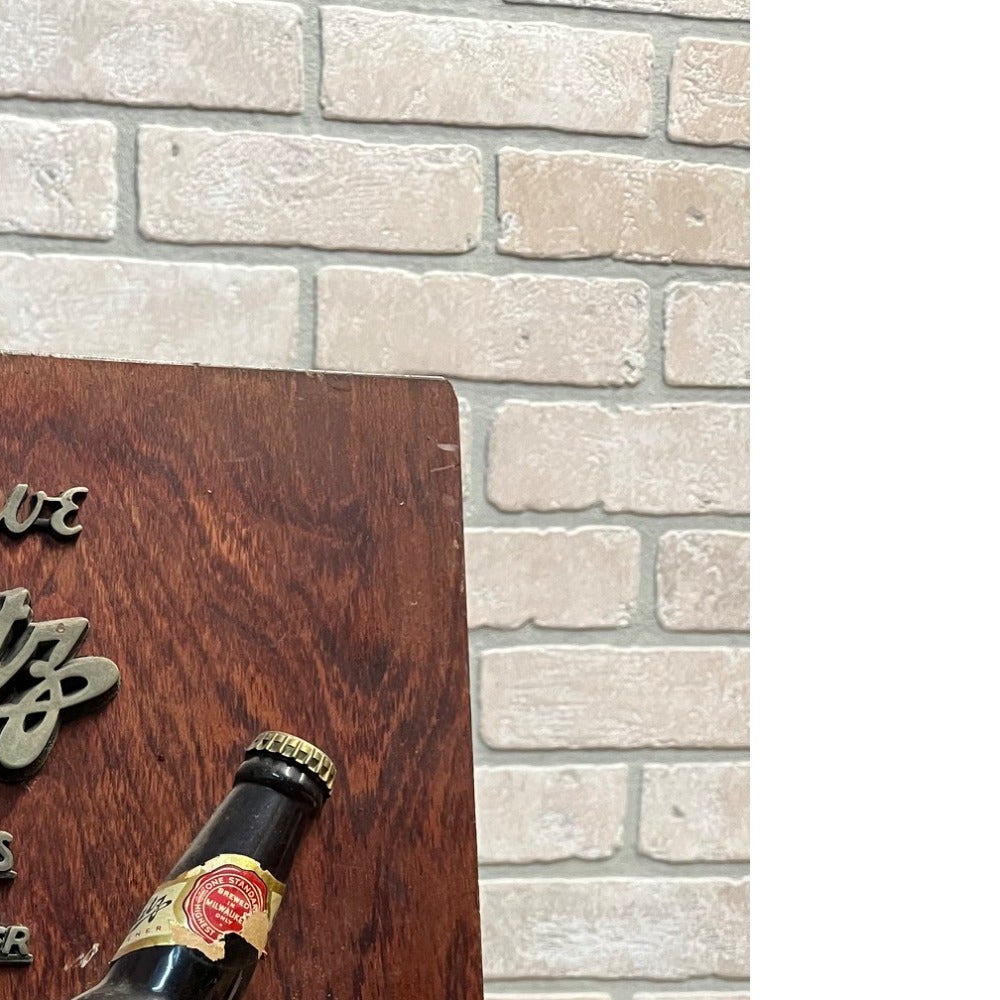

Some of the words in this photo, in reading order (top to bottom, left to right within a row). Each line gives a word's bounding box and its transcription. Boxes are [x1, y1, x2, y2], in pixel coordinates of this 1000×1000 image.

[205, 877, 225, 891] ONE
[229, 876, 260, 914] STANDAR
[217, 886, 250, 910] BREWED
[206, 898, 244, 924] MILWAUKE
[215, 913, 233, 925] ONLY
